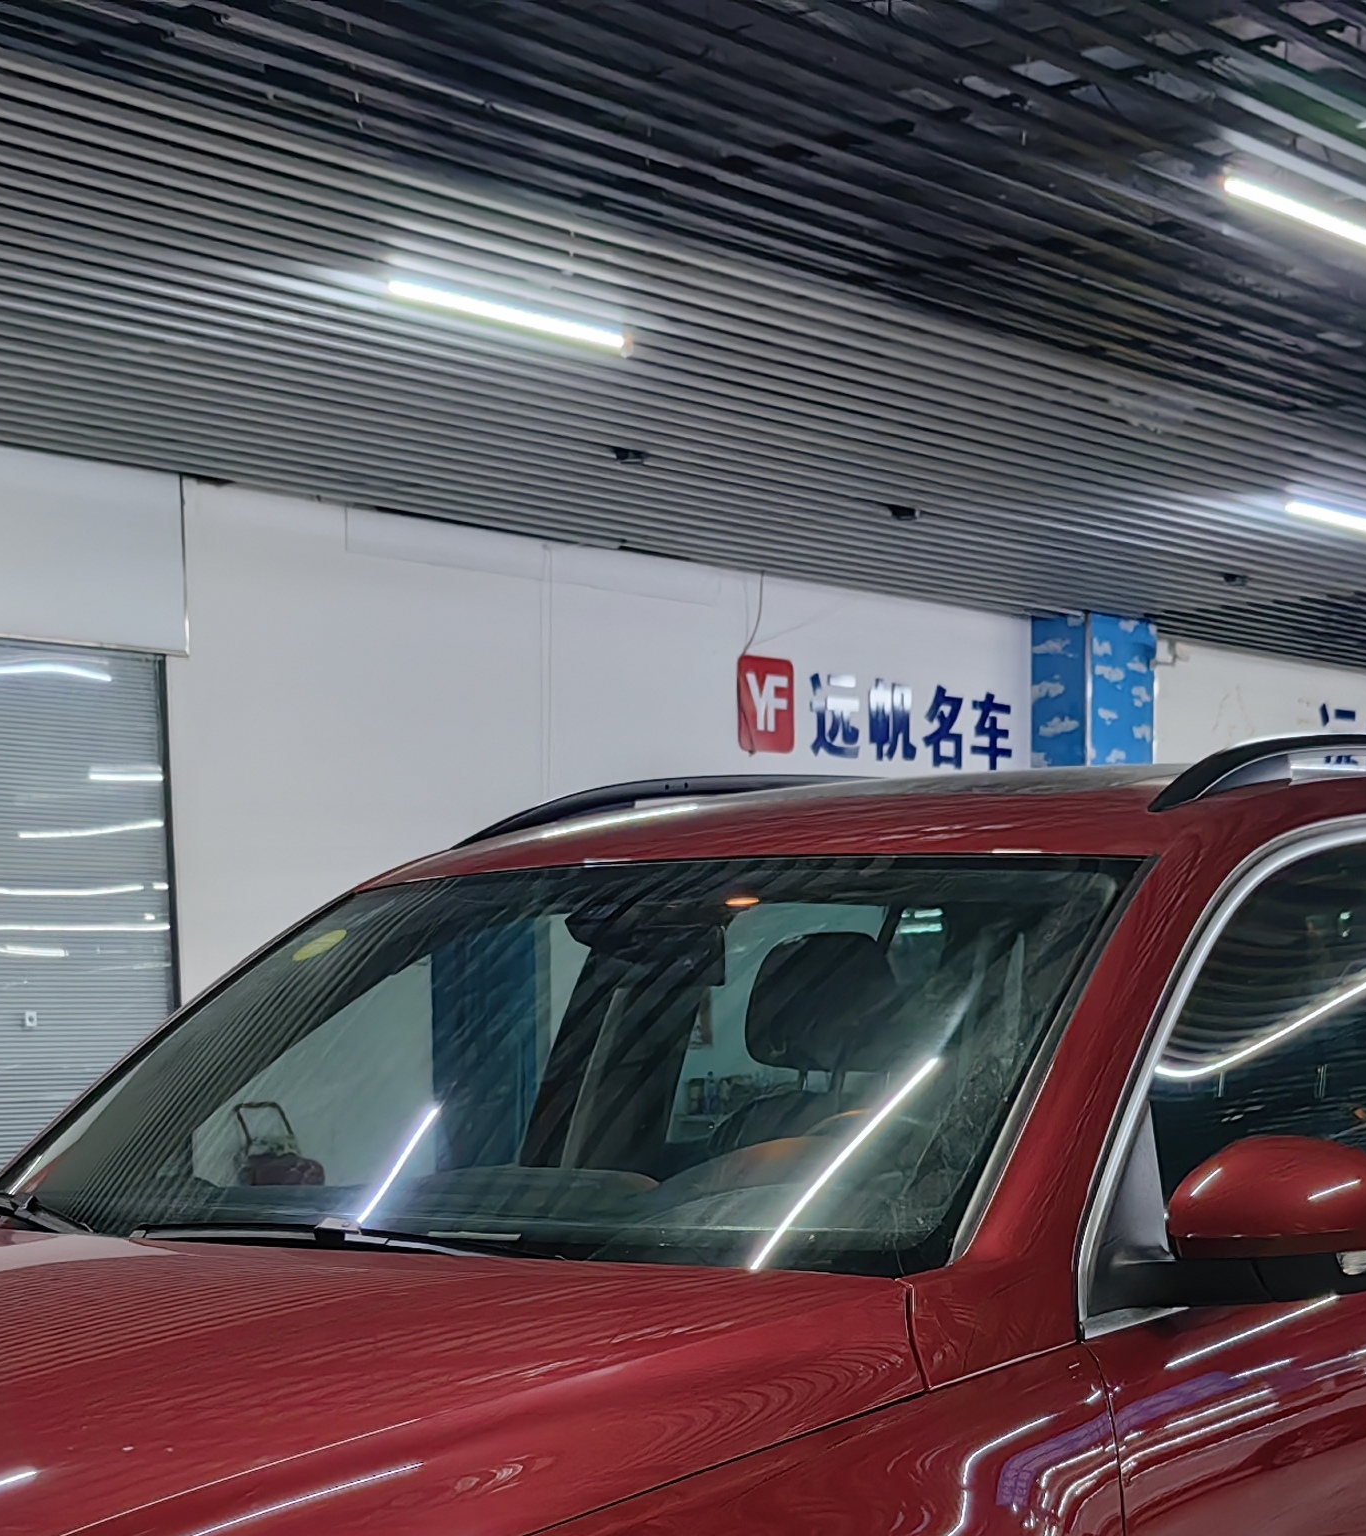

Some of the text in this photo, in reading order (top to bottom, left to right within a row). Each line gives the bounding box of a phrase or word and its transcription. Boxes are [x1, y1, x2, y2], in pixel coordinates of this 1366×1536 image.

[745, 672, 789, 733] YF
[809, 672, 1013, 771] 远帆名车
